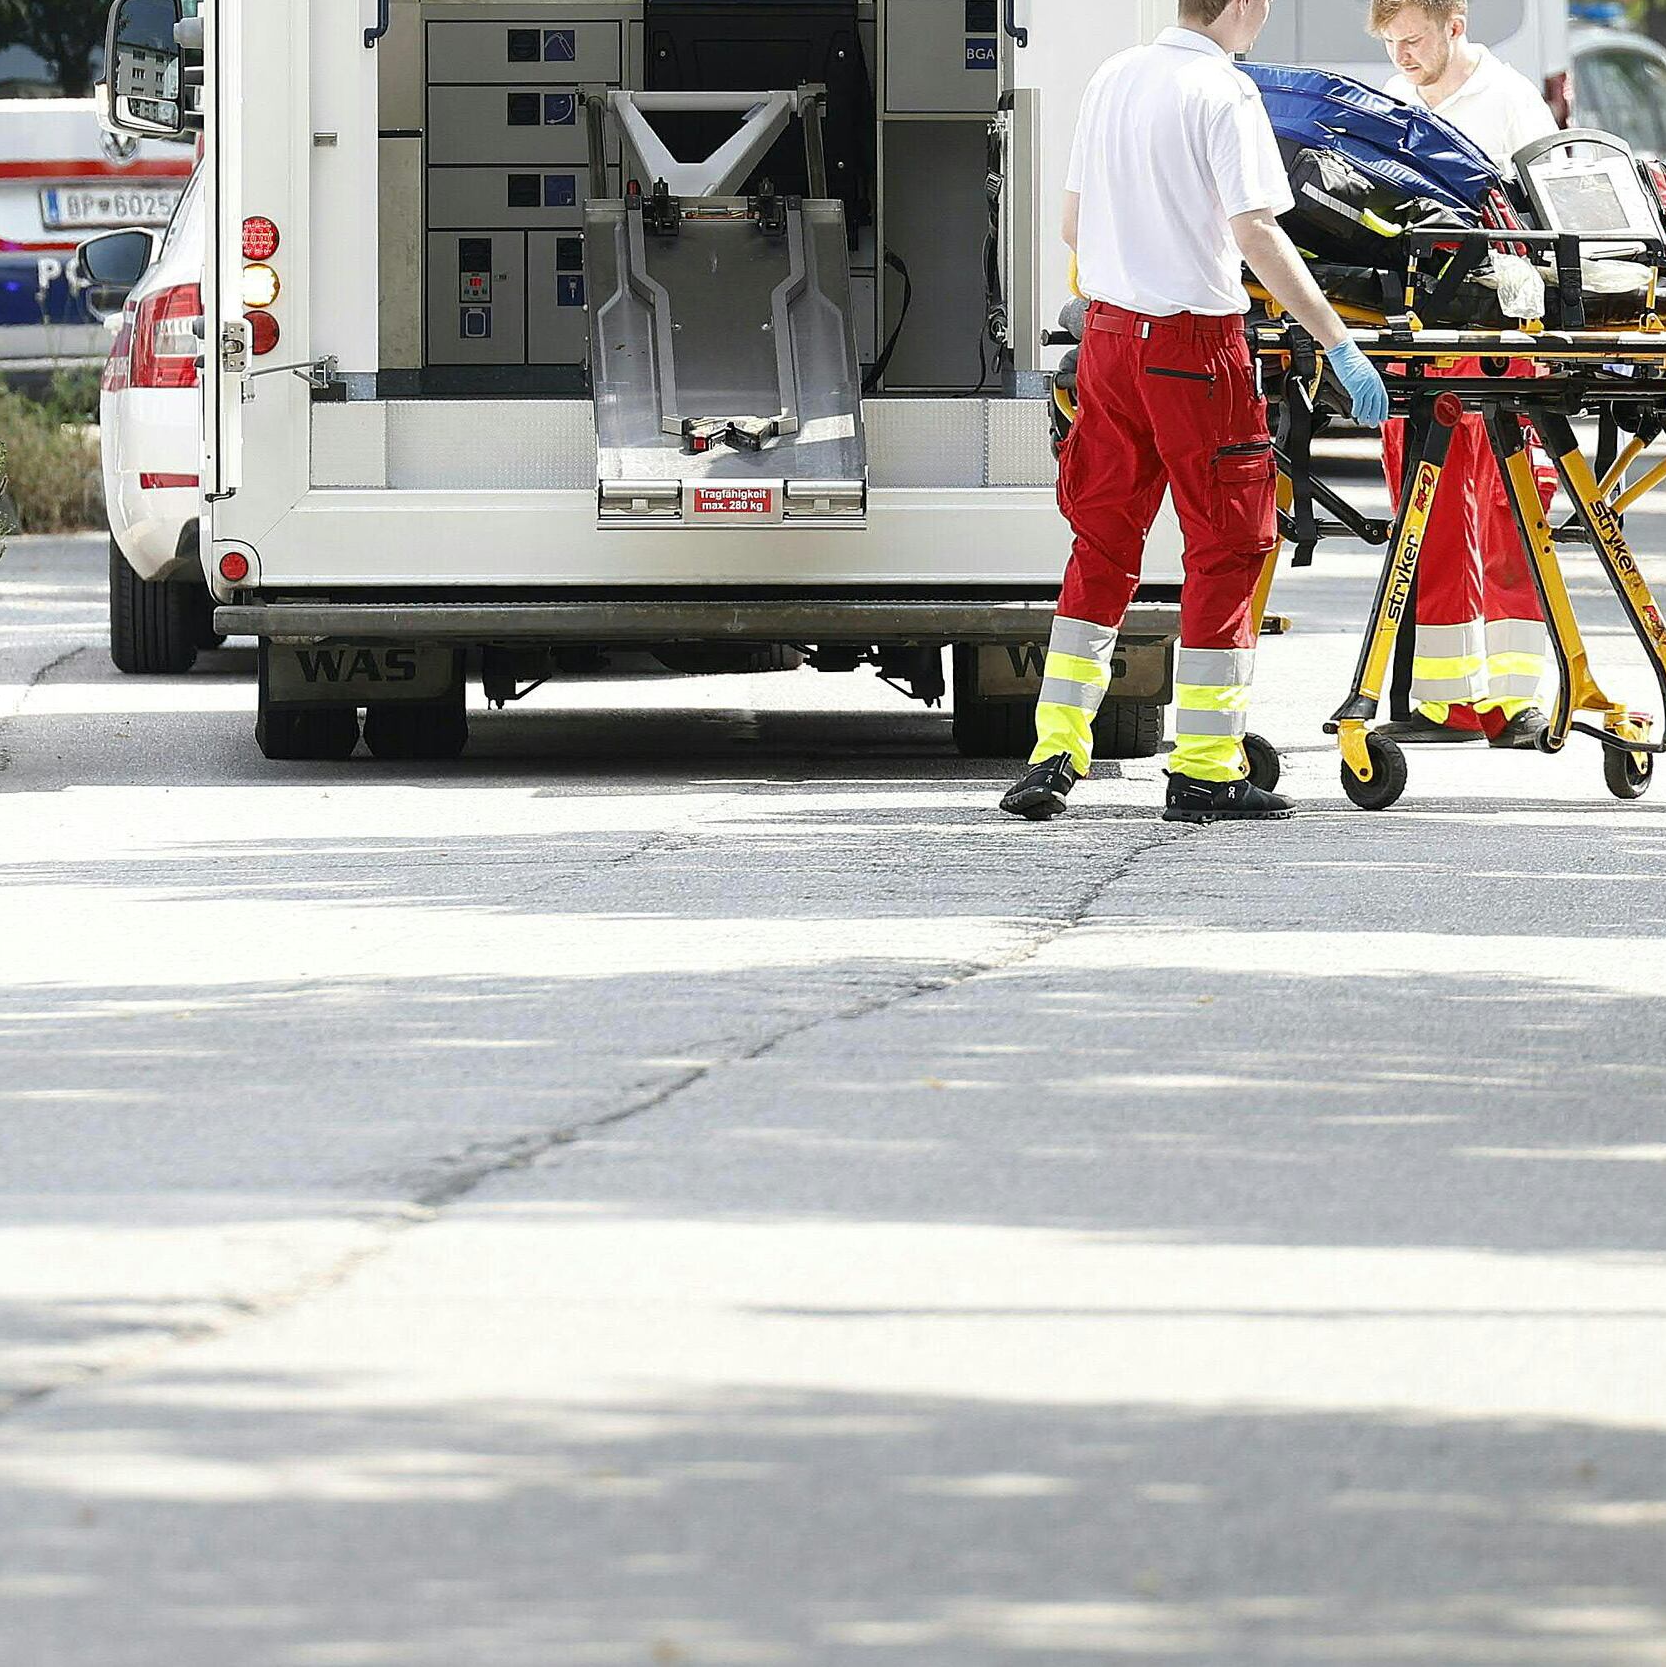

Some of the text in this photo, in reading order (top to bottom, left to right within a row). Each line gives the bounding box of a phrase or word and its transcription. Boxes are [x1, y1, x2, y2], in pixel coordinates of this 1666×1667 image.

[966, 48, 995, 60] BGA
[114, 193, 180, 218] 6025
[699, 489, 766, 500] Tragfähigkeit
[702, 501, 763, 511] max. 280 kg
[1590, 500, 1637, 576] stryker
[1388, 534, 1419, 624] stryker
[295, 649, 417, 682] WAS
[1006, 646, 1127, 679] WS
